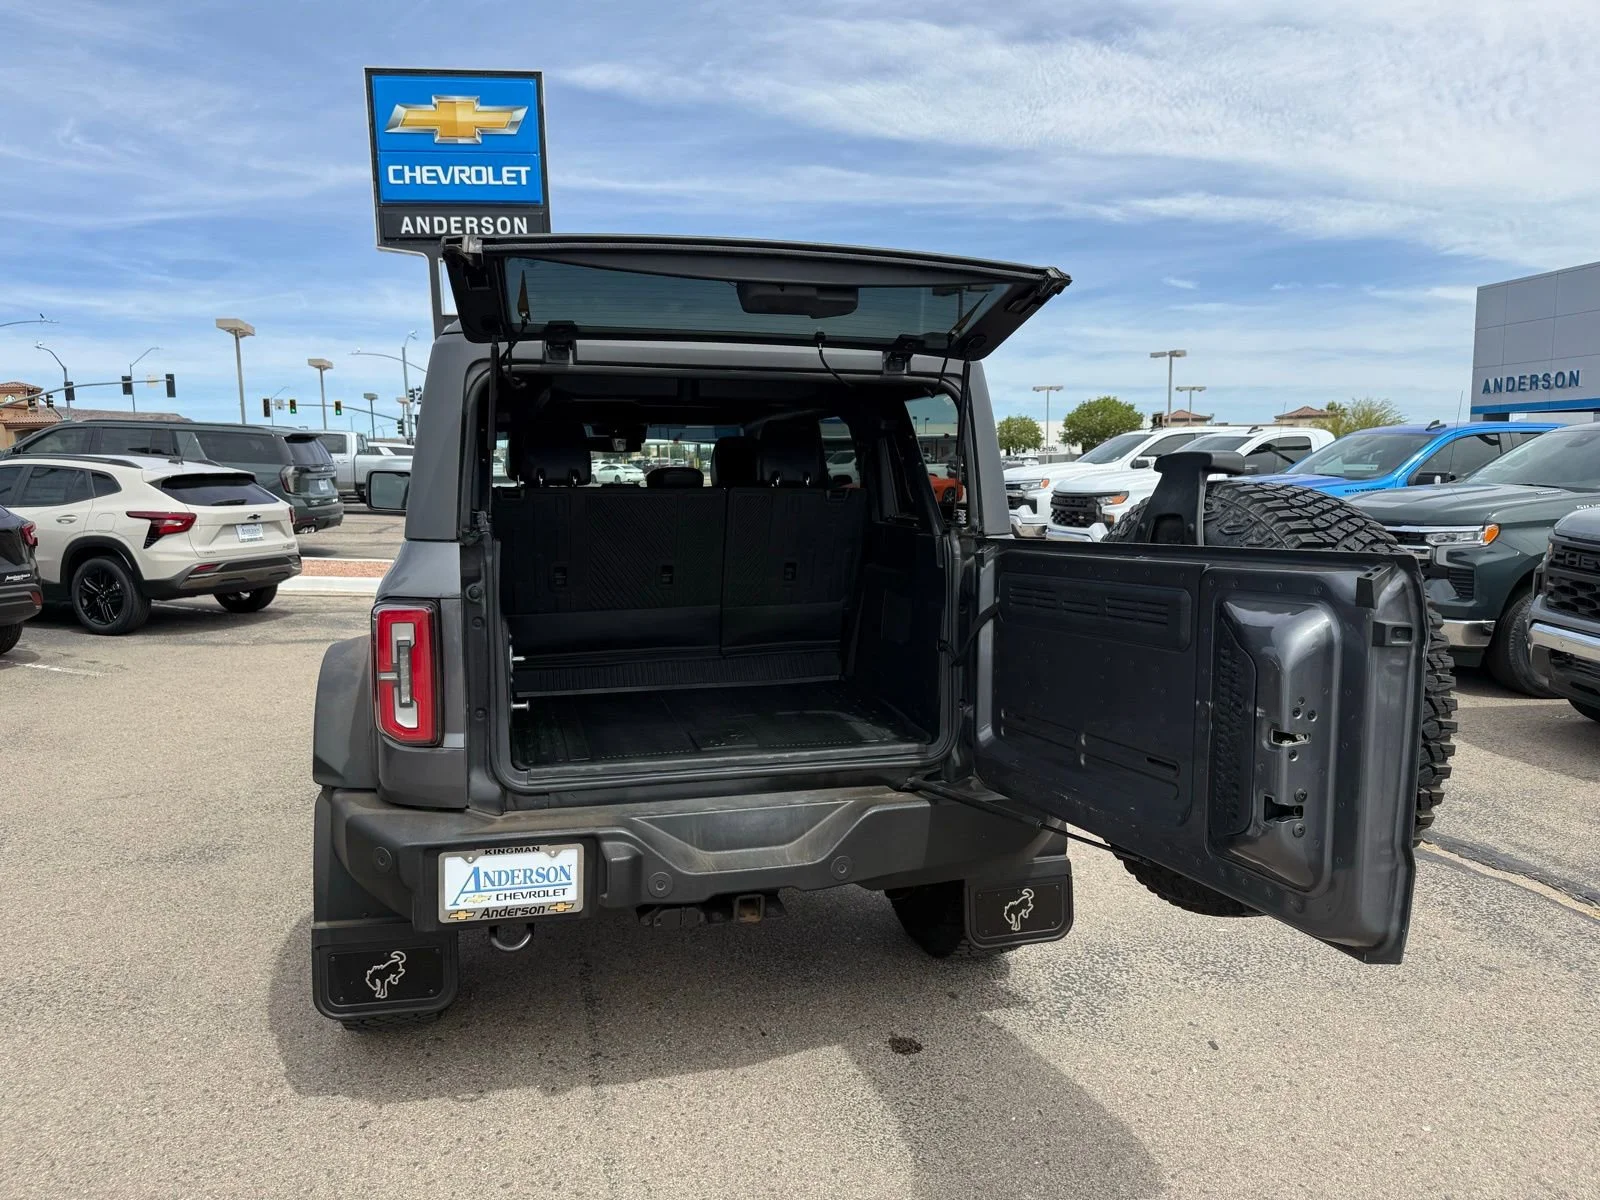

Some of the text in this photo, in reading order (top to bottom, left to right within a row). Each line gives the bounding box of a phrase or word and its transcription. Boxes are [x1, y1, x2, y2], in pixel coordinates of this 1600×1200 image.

[388, 165, 530, 185] CHEVROLET
[400, 216, 528, 235] ANDERSON
[1482, 369, 1580, 394] ANDERSON
[484, 846, 540, 855] KINGMAN
[496, 888, 568, 901] CHEVROLET
[480, 905, 545, 919] Anderson
